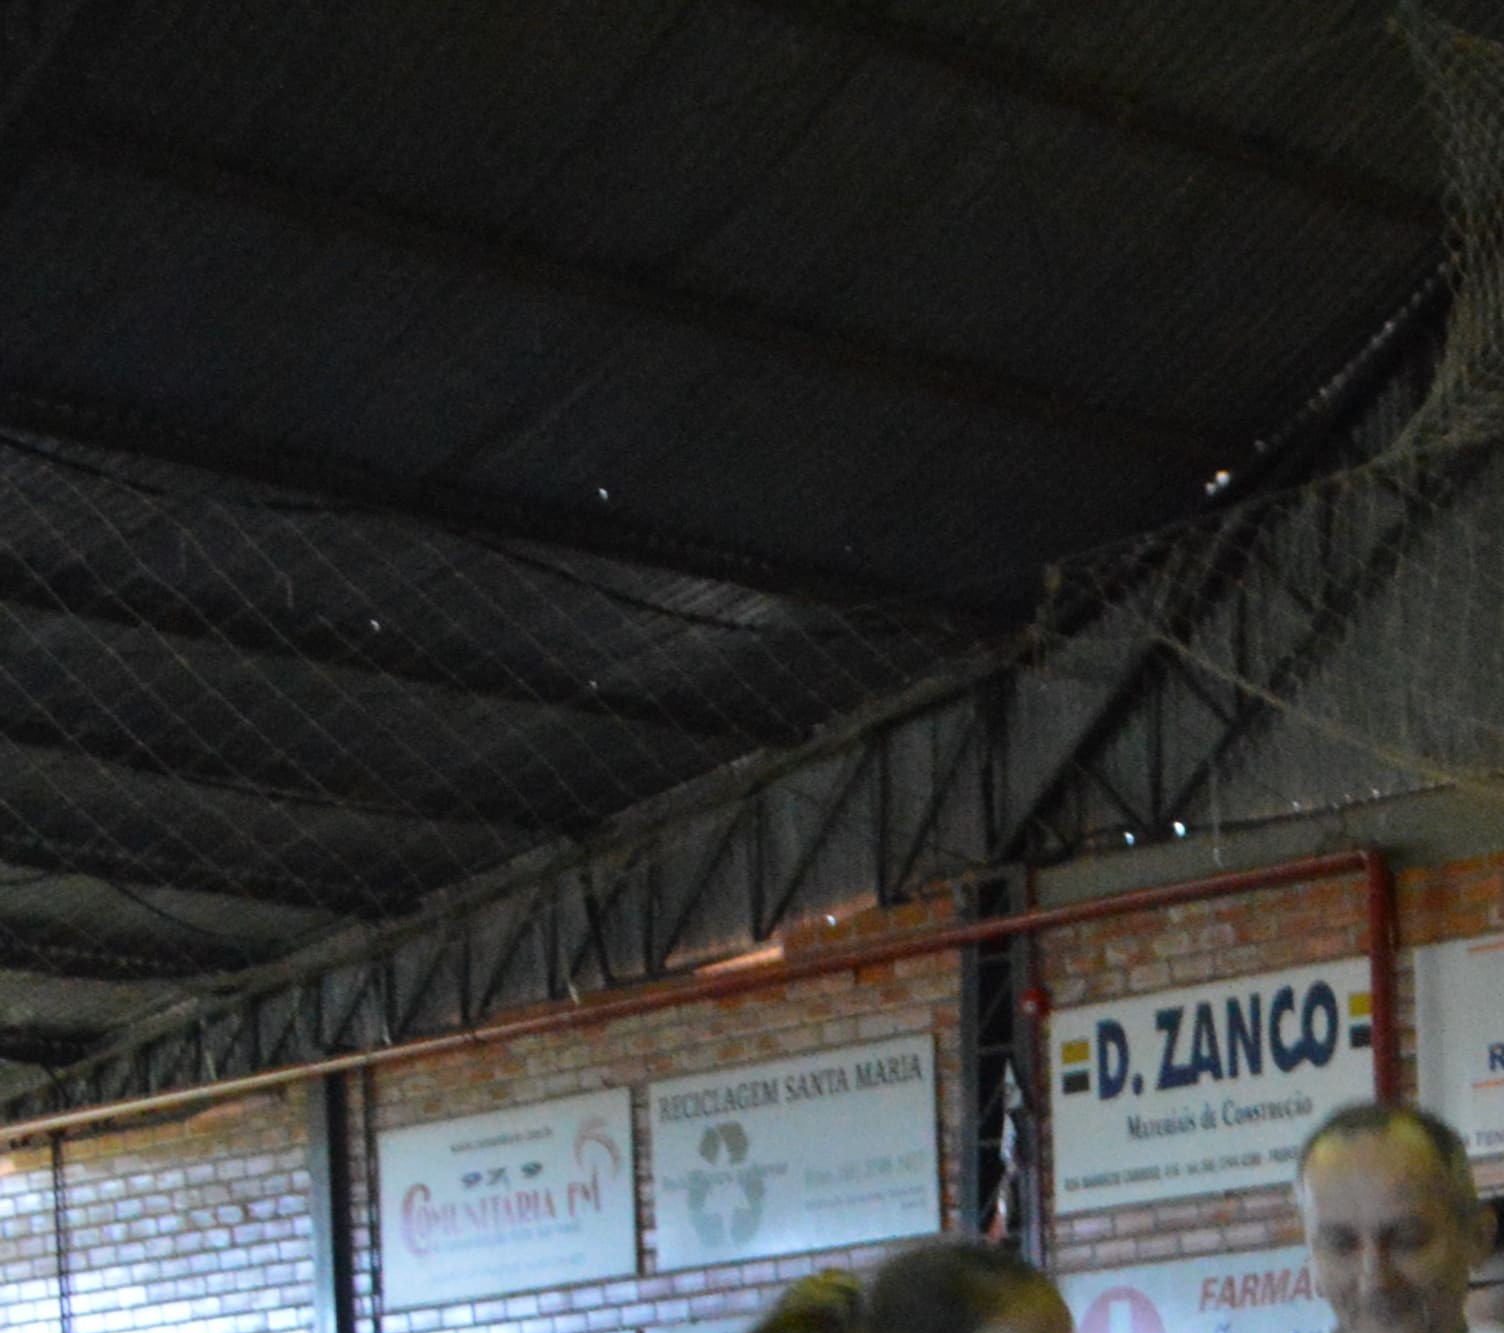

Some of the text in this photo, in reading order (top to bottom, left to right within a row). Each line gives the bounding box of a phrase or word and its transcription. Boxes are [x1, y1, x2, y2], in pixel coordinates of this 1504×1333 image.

[1097, 980, 1339, 1101] D. ZANCO
[657, 1053, 924, 1122] RECICLAGEM SANTA MARIA
[1200, 1102, 1218, 1130] de
[1222, 1091, 1313, 1127] Construção
